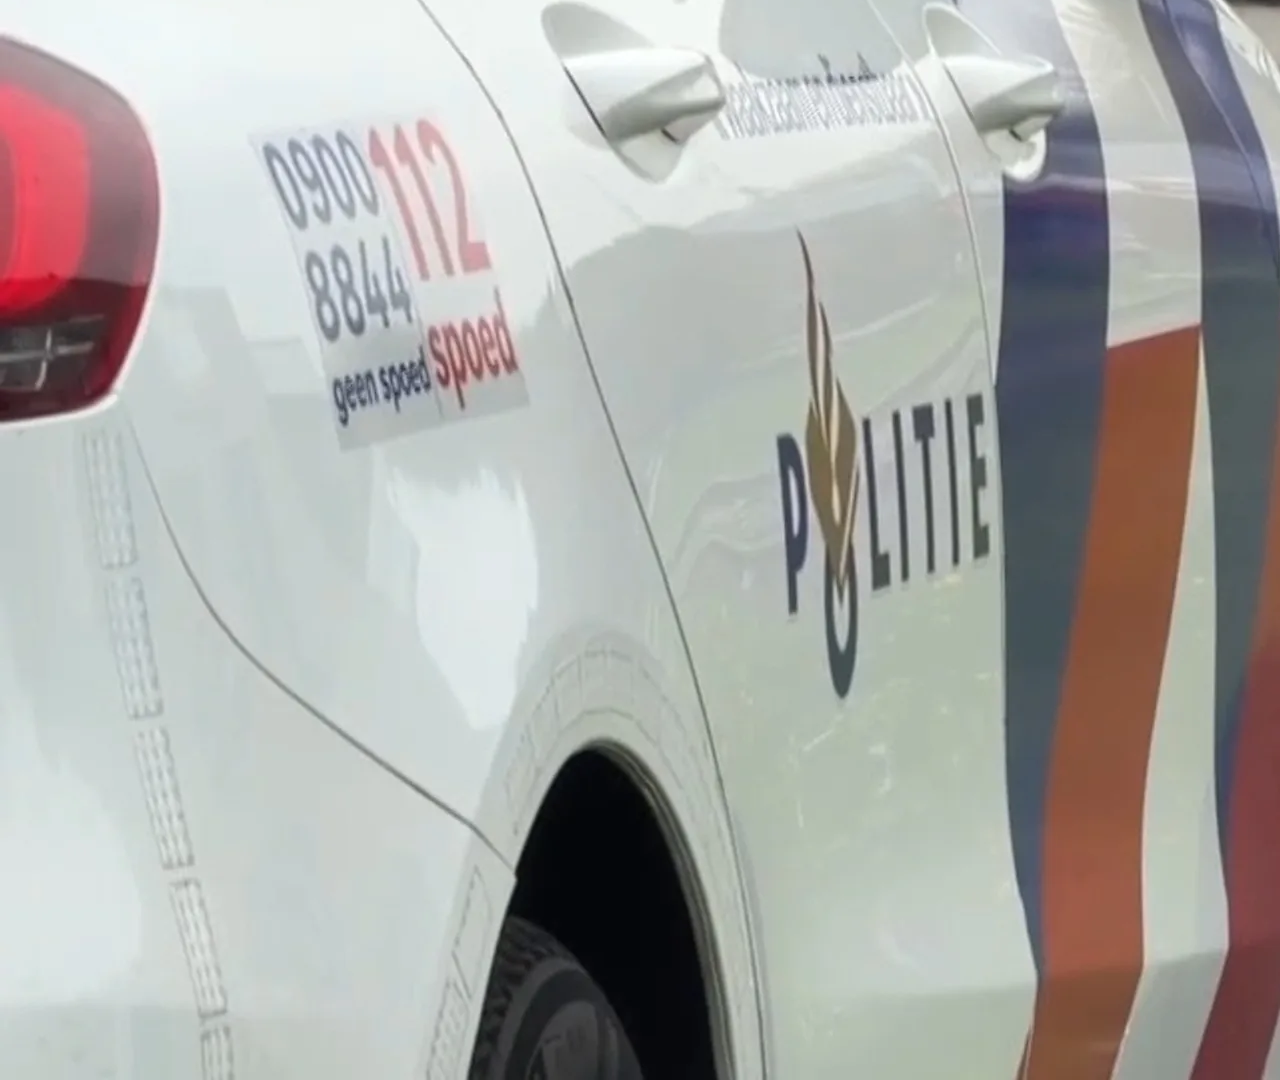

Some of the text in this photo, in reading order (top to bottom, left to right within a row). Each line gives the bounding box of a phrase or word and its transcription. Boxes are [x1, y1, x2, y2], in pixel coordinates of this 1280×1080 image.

[262, 128, 380, 232] 0900
[368, 117, 493, 283] 112
[304, 233, 414, 343] 8844
[332, 344, 433, 427] geen spoed
[427, 284, 520, 412] spoed
[776, 392, 990, 700] POLITIE
